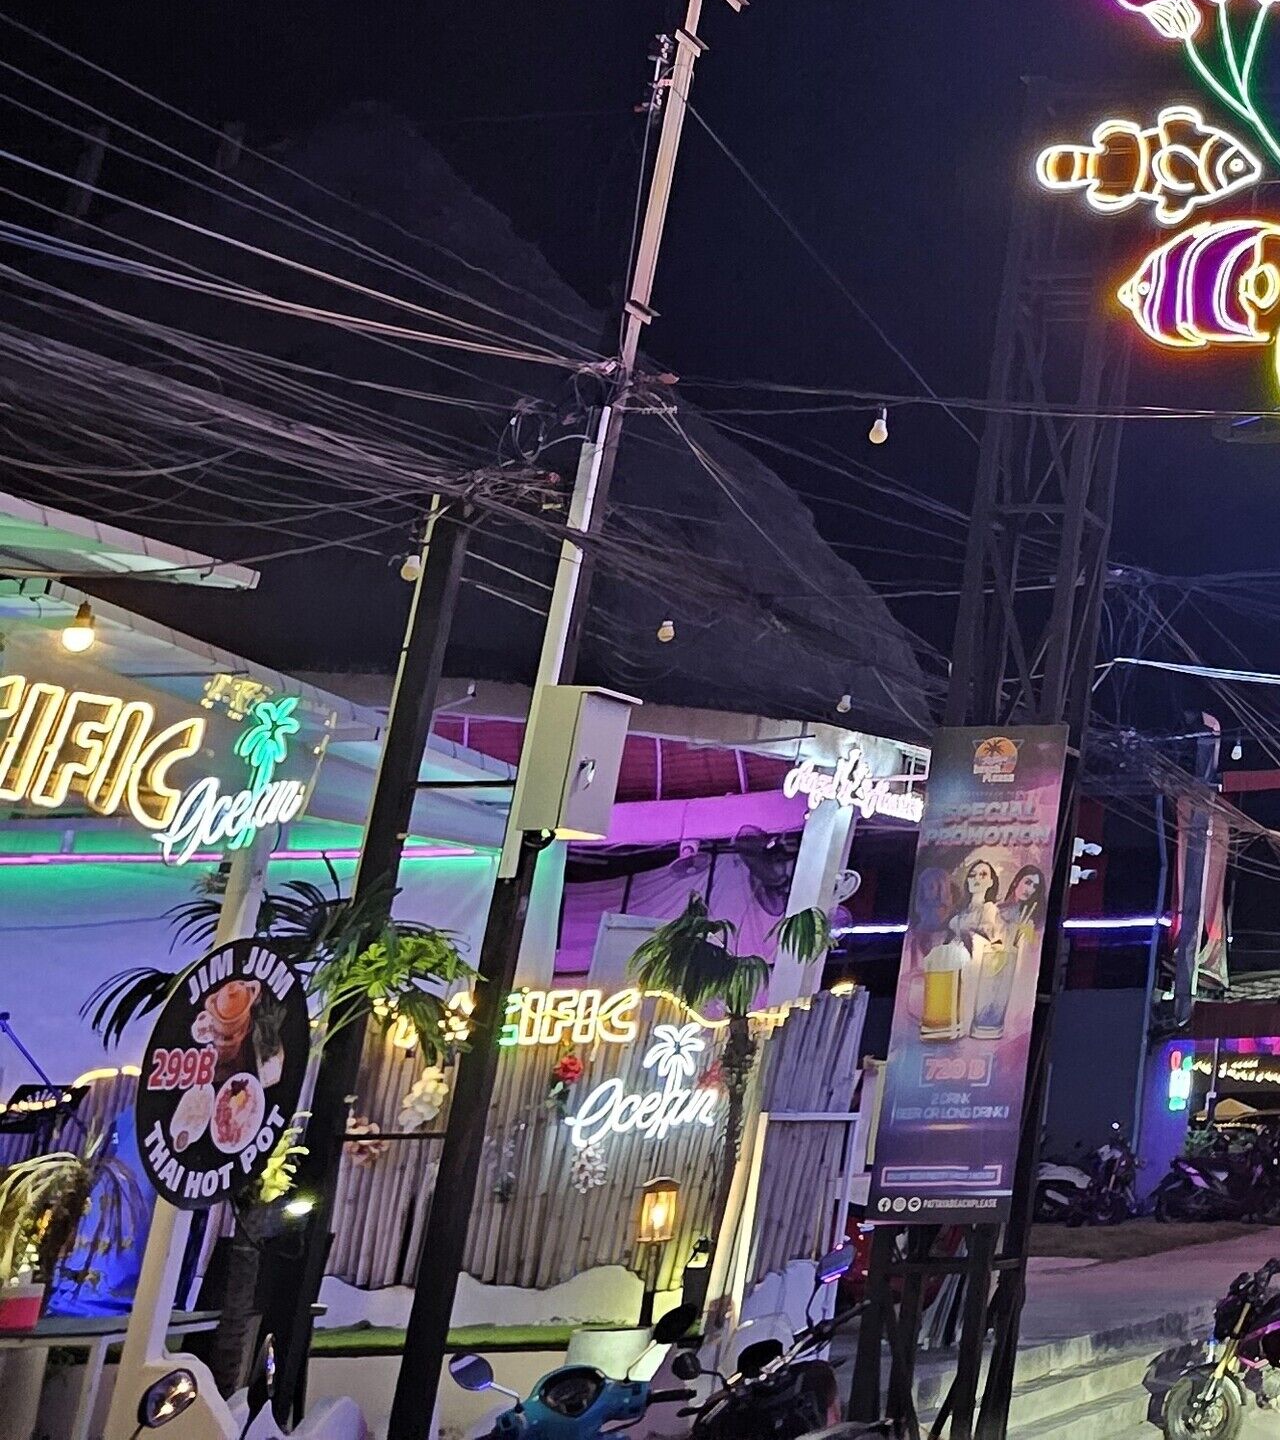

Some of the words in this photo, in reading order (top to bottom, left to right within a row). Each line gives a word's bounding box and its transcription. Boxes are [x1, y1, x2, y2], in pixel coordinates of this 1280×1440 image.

[0, 674, 206, 829] IFIC
[152, 776, 304, 866] Ocean
[924, 824, 1050, 847] PROMOTION
[940, 800, 1038, 825] SPECIAL
[188, 948, 234, 1005] JIM
[242, 946, 295, 1001] JUM
[565, 1077, 719, 1149] Ocean
[144, 1120, 186, 1192] THAI
[184, 1162, 234, 1200] HOT
[240, 1104, 286, 1175] POT
